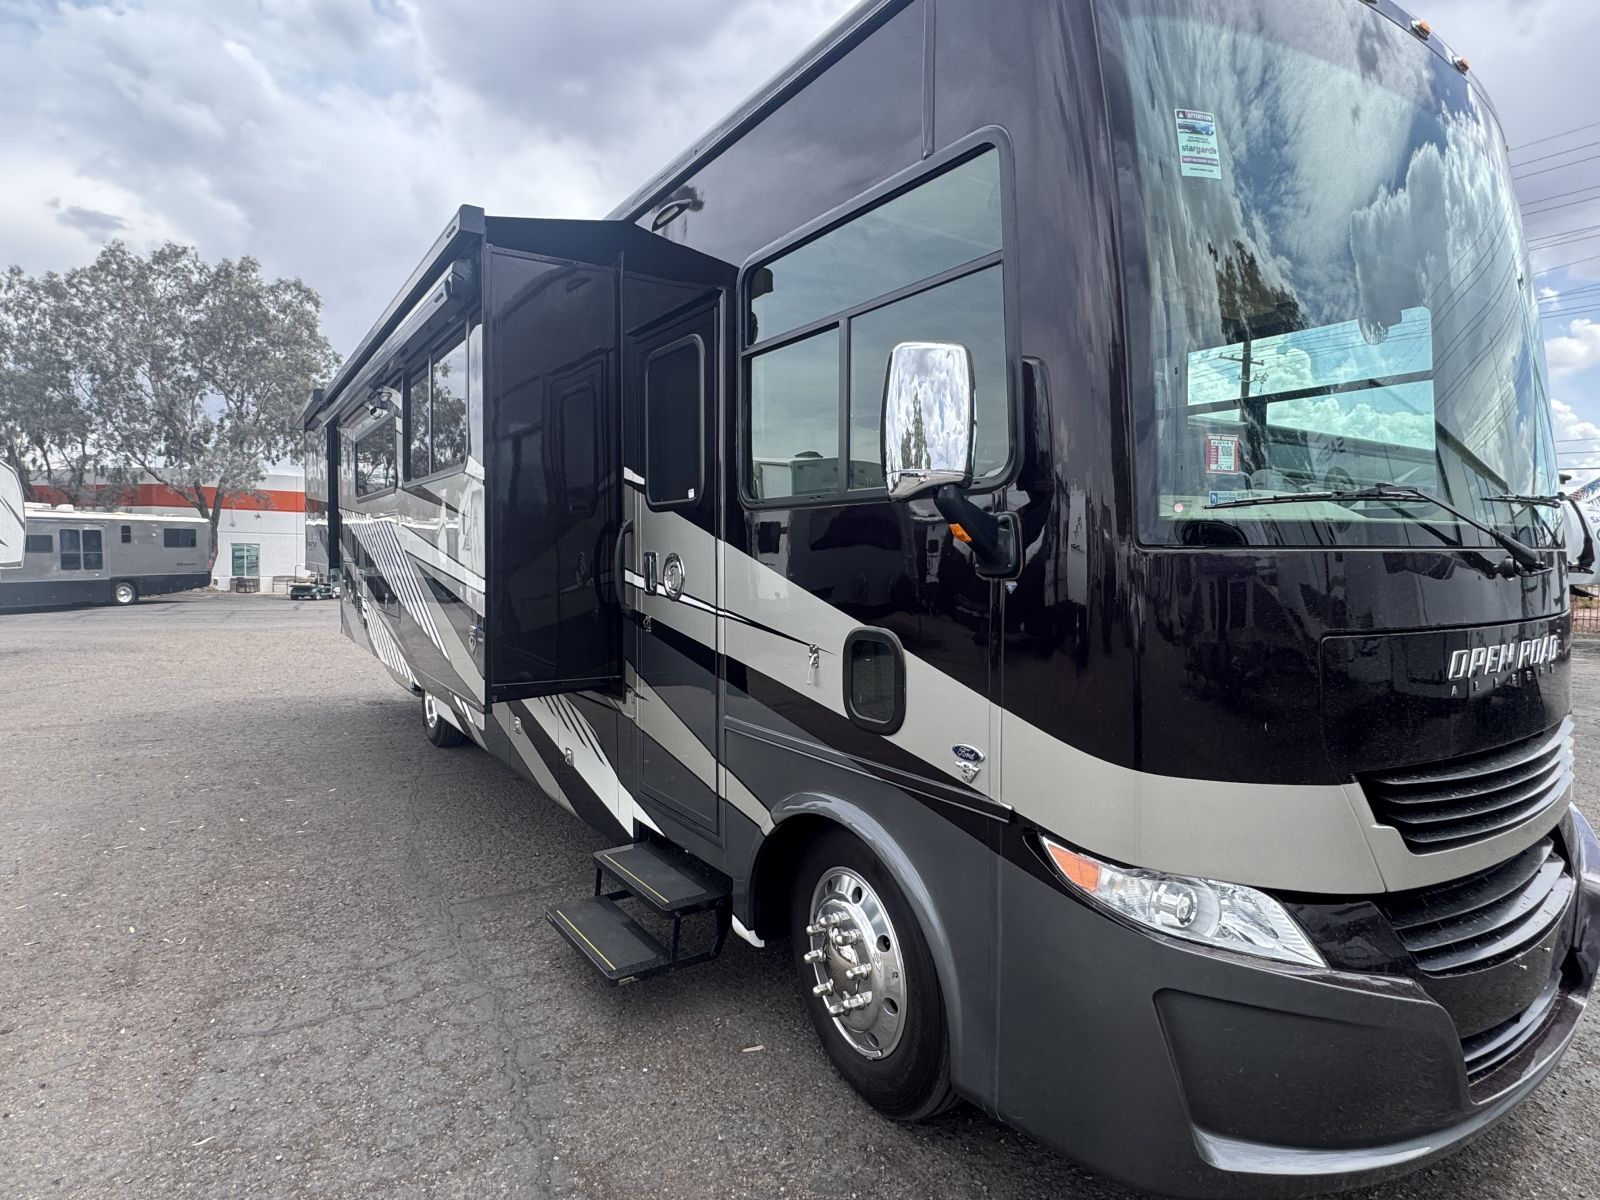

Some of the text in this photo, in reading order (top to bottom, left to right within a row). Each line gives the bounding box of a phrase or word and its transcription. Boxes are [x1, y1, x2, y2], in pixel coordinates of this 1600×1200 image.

[1448, 635, 1559, 680] OPEN ROAD
[955, 746, 979, 761] Ford
